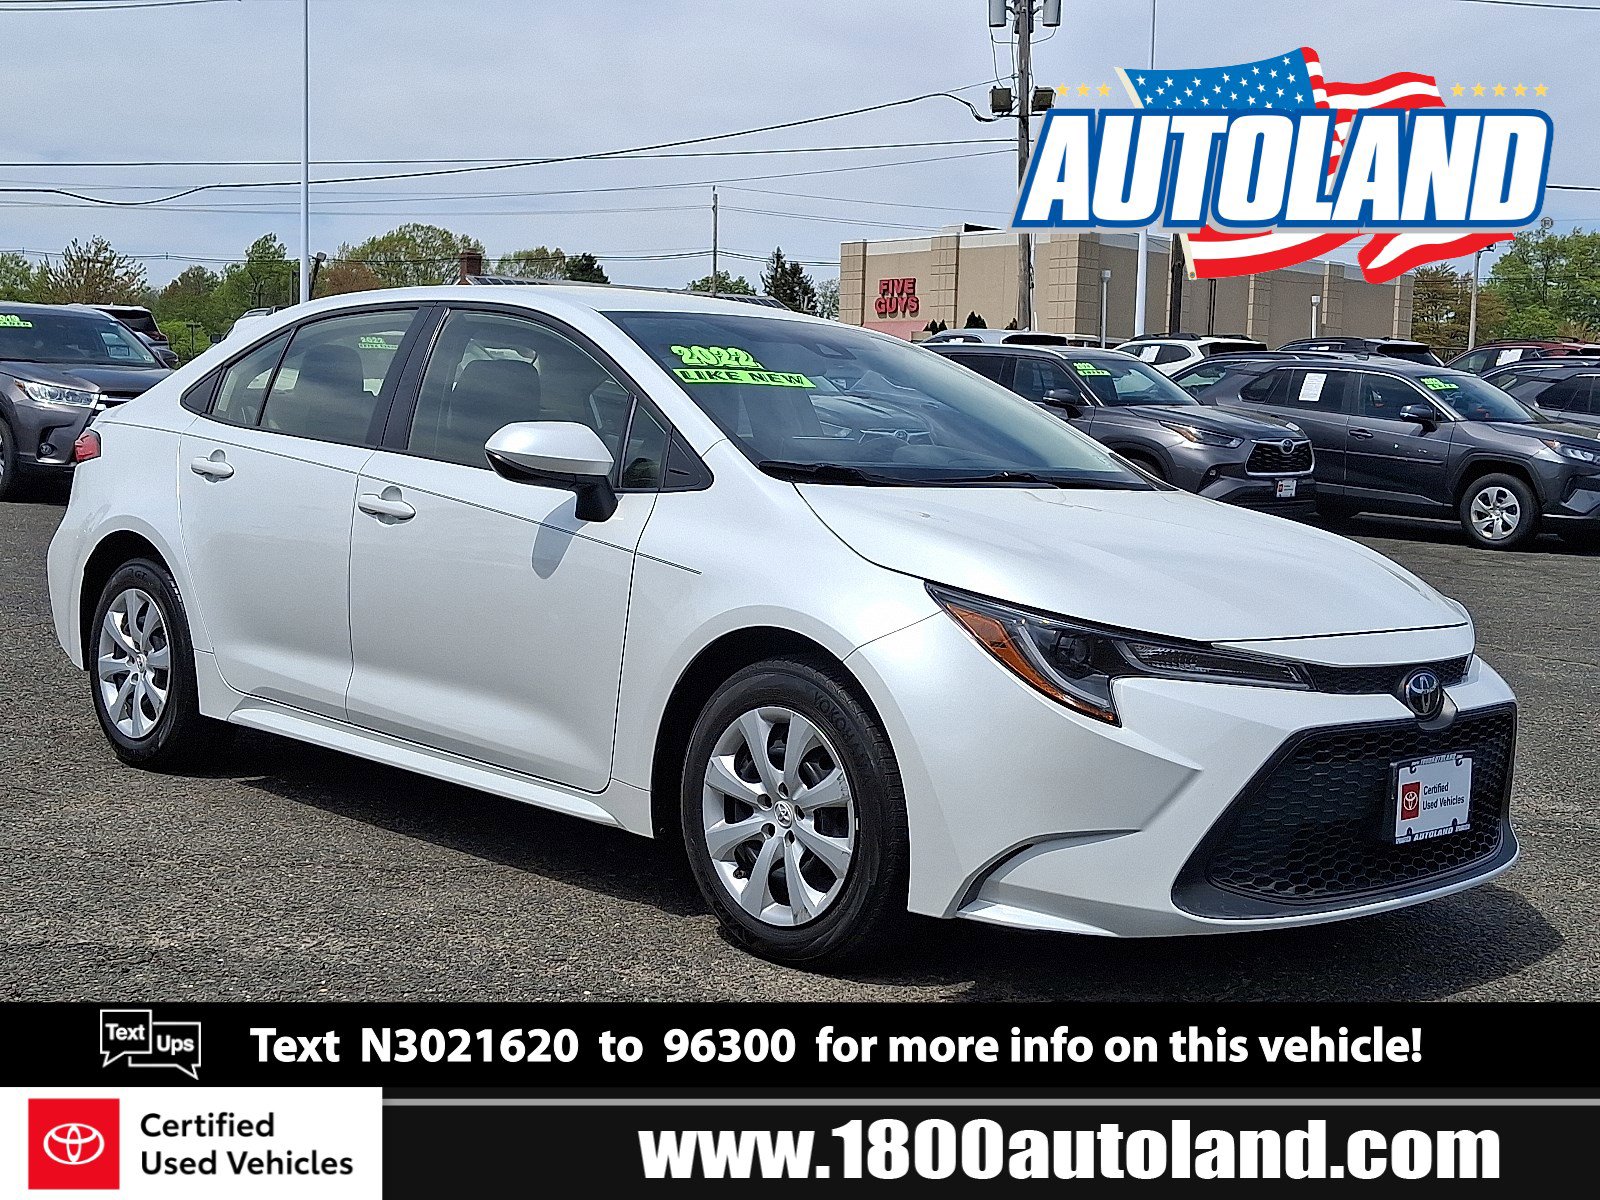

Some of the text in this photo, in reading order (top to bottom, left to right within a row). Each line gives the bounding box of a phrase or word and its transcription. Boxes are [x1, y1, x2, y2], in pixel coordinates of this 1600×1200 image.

[879, 278, 916, 296] FIVE
[875, 296, 919, 315] GUYS
[670, 345, 762, 369] 2022
[679, 370, 806, 385] LIKE NEW
[1423, 782, 1449, 796] Certified
[1422, 794, 1465, 811] Used Vehicles
[1413, 826, 1454, 842] AUTOLAND
